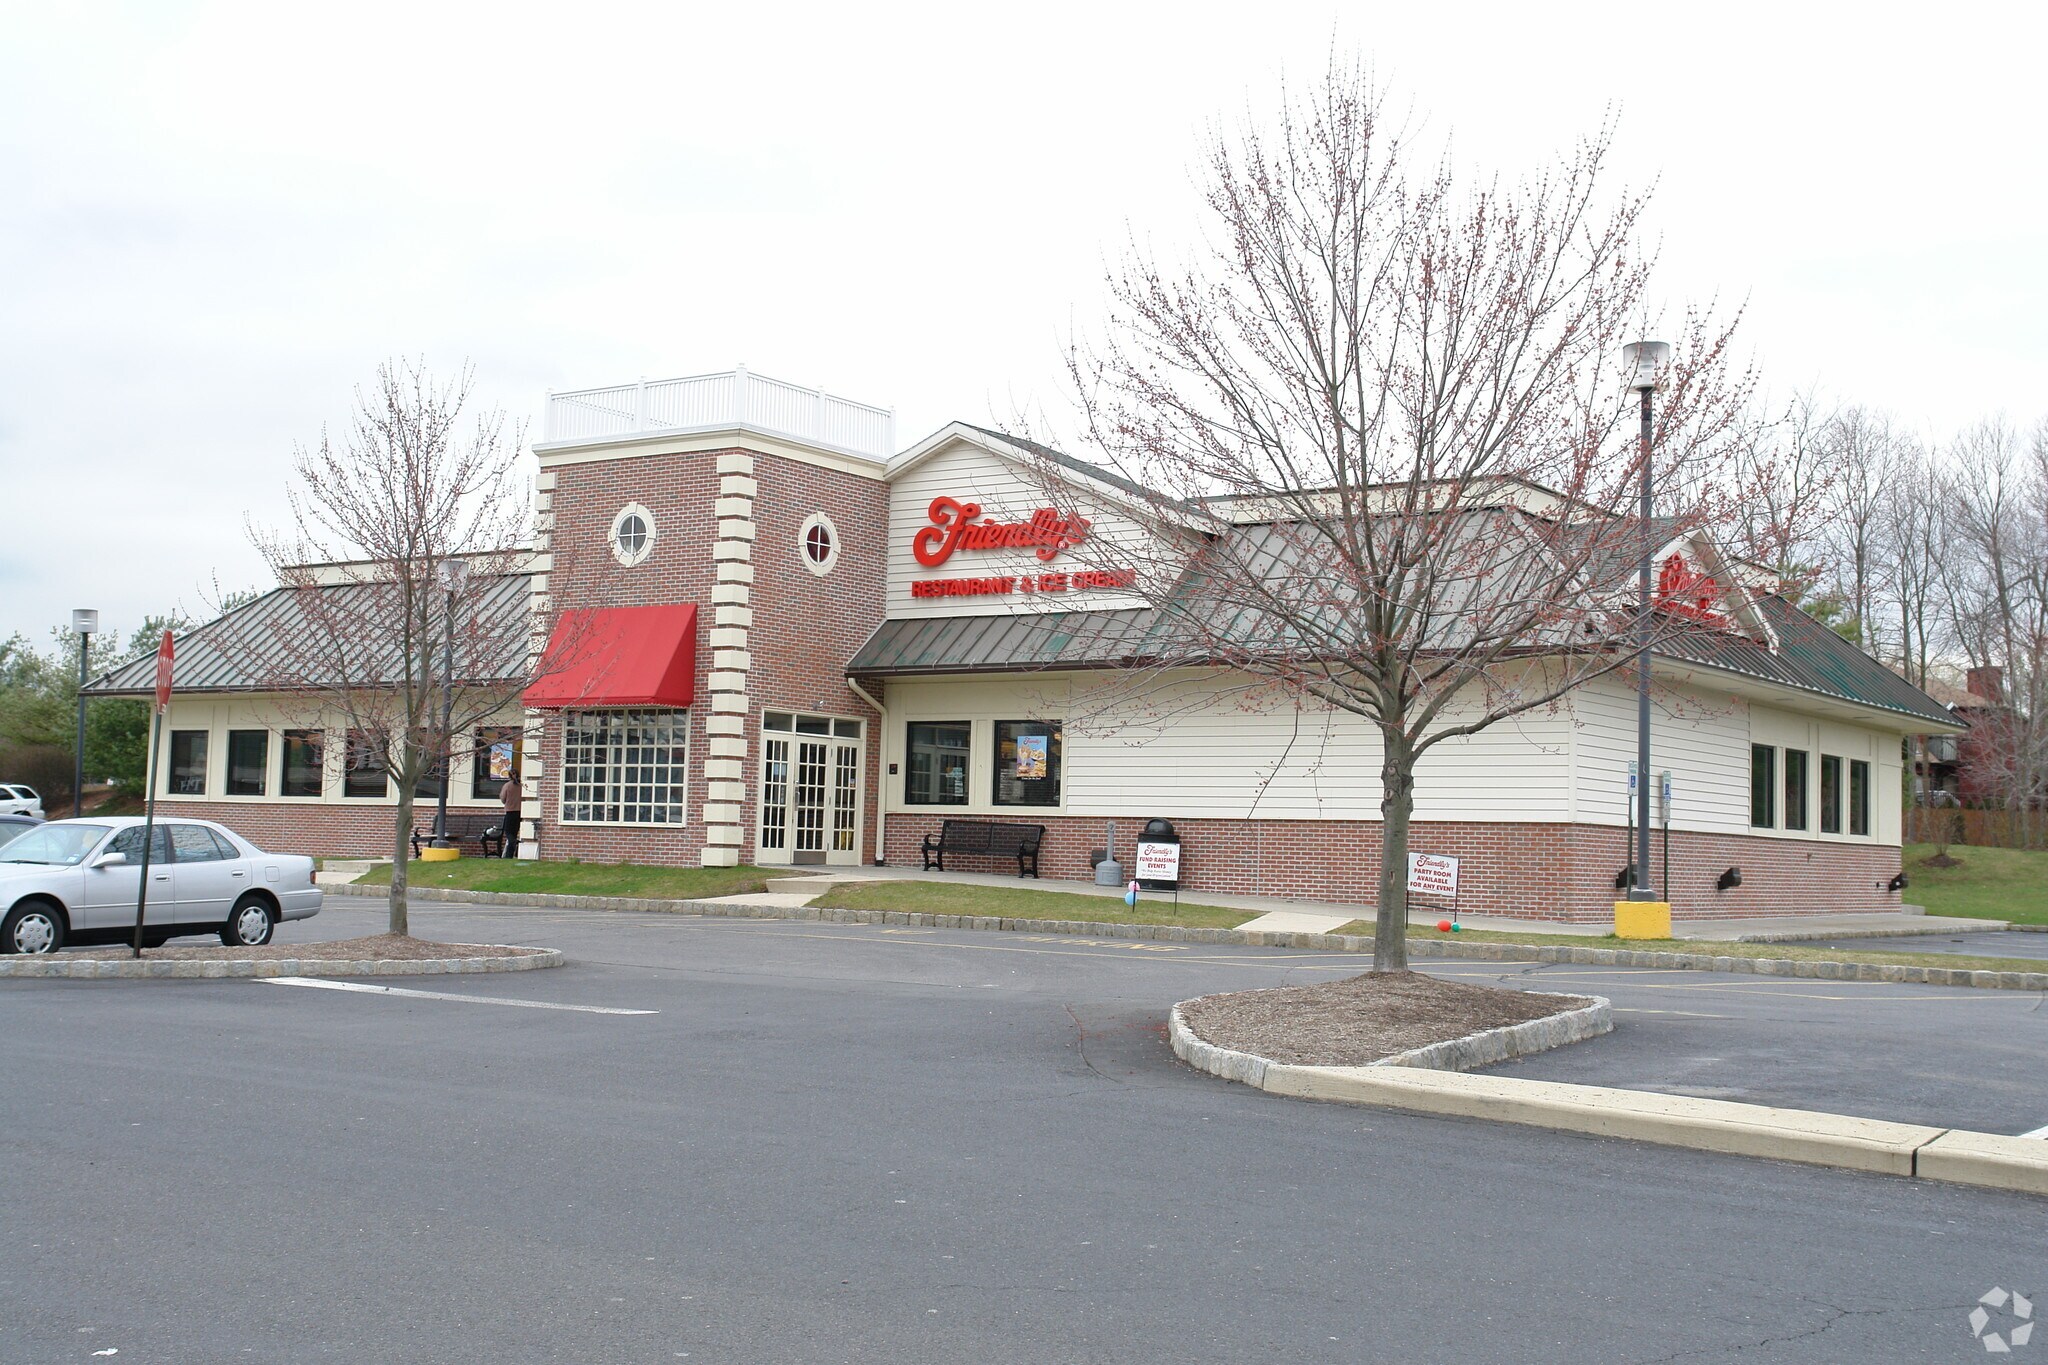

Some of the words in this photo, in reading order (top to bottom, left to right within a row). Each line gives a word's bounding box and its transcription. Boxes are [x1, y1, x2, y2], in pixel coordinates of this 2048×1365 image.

[913, 496, 1091, 566] Friendly's
[912, 577, 1016, 597] RESTAURANT
[1020, 576, 1034, 593] &
[1038, 573, 1067, 592] ICE
[157, 655, 173, 688] STOP
[1417, 875, 1448, 884] AVAILABLE
